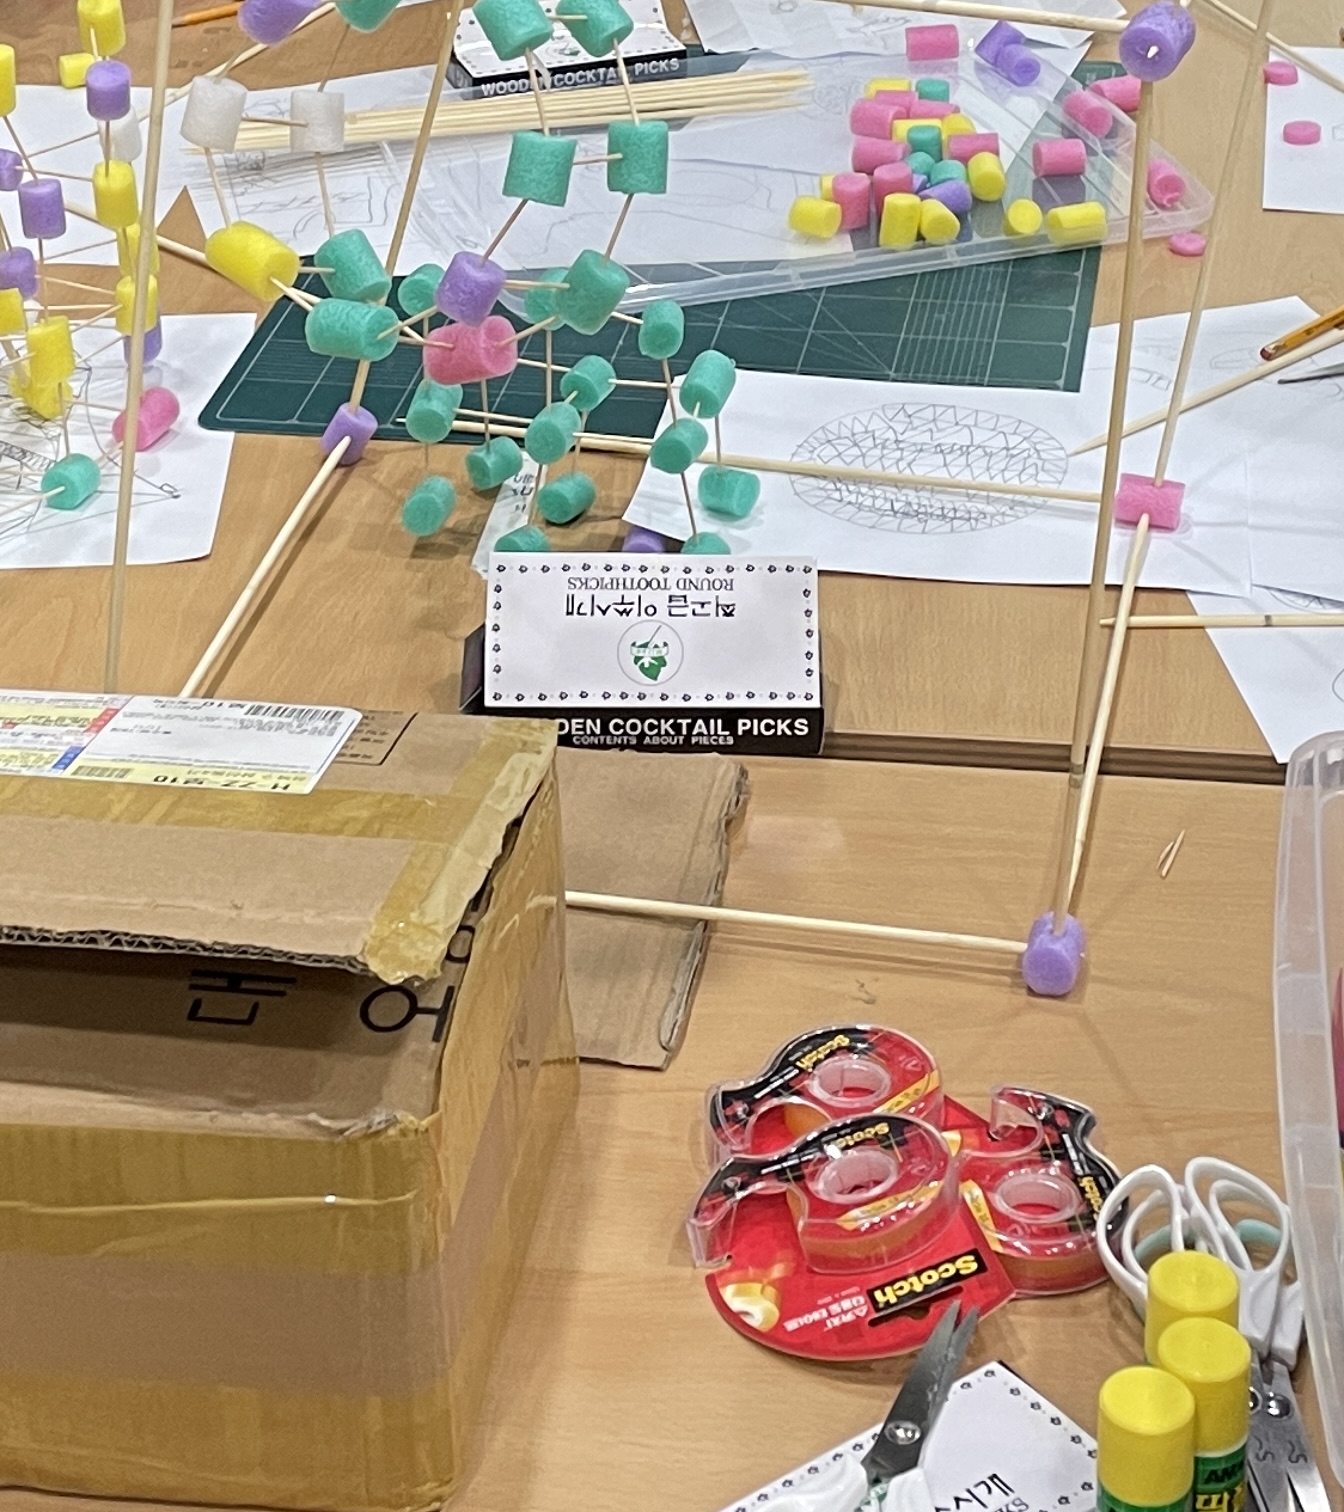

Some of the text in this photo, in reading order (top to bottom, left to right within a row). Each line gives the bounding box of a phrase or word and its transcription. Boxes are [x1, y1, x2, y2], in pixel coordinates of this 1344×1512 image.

[481, 57, 681, 98] WOOD COCKTA PICKS
[567, 574, 735, 593] ROUND TOOTHPICKS
[564, 591, 737, 619] 최고급 이쑤시개
[607, 716, 731, 739] COCKTAIL
[735, 716, 810, 739] PICKS
[571, 734, 735, 748] CONTENTS ABOUT PIECES
[873, 1254, 979, 1305] Scotch
